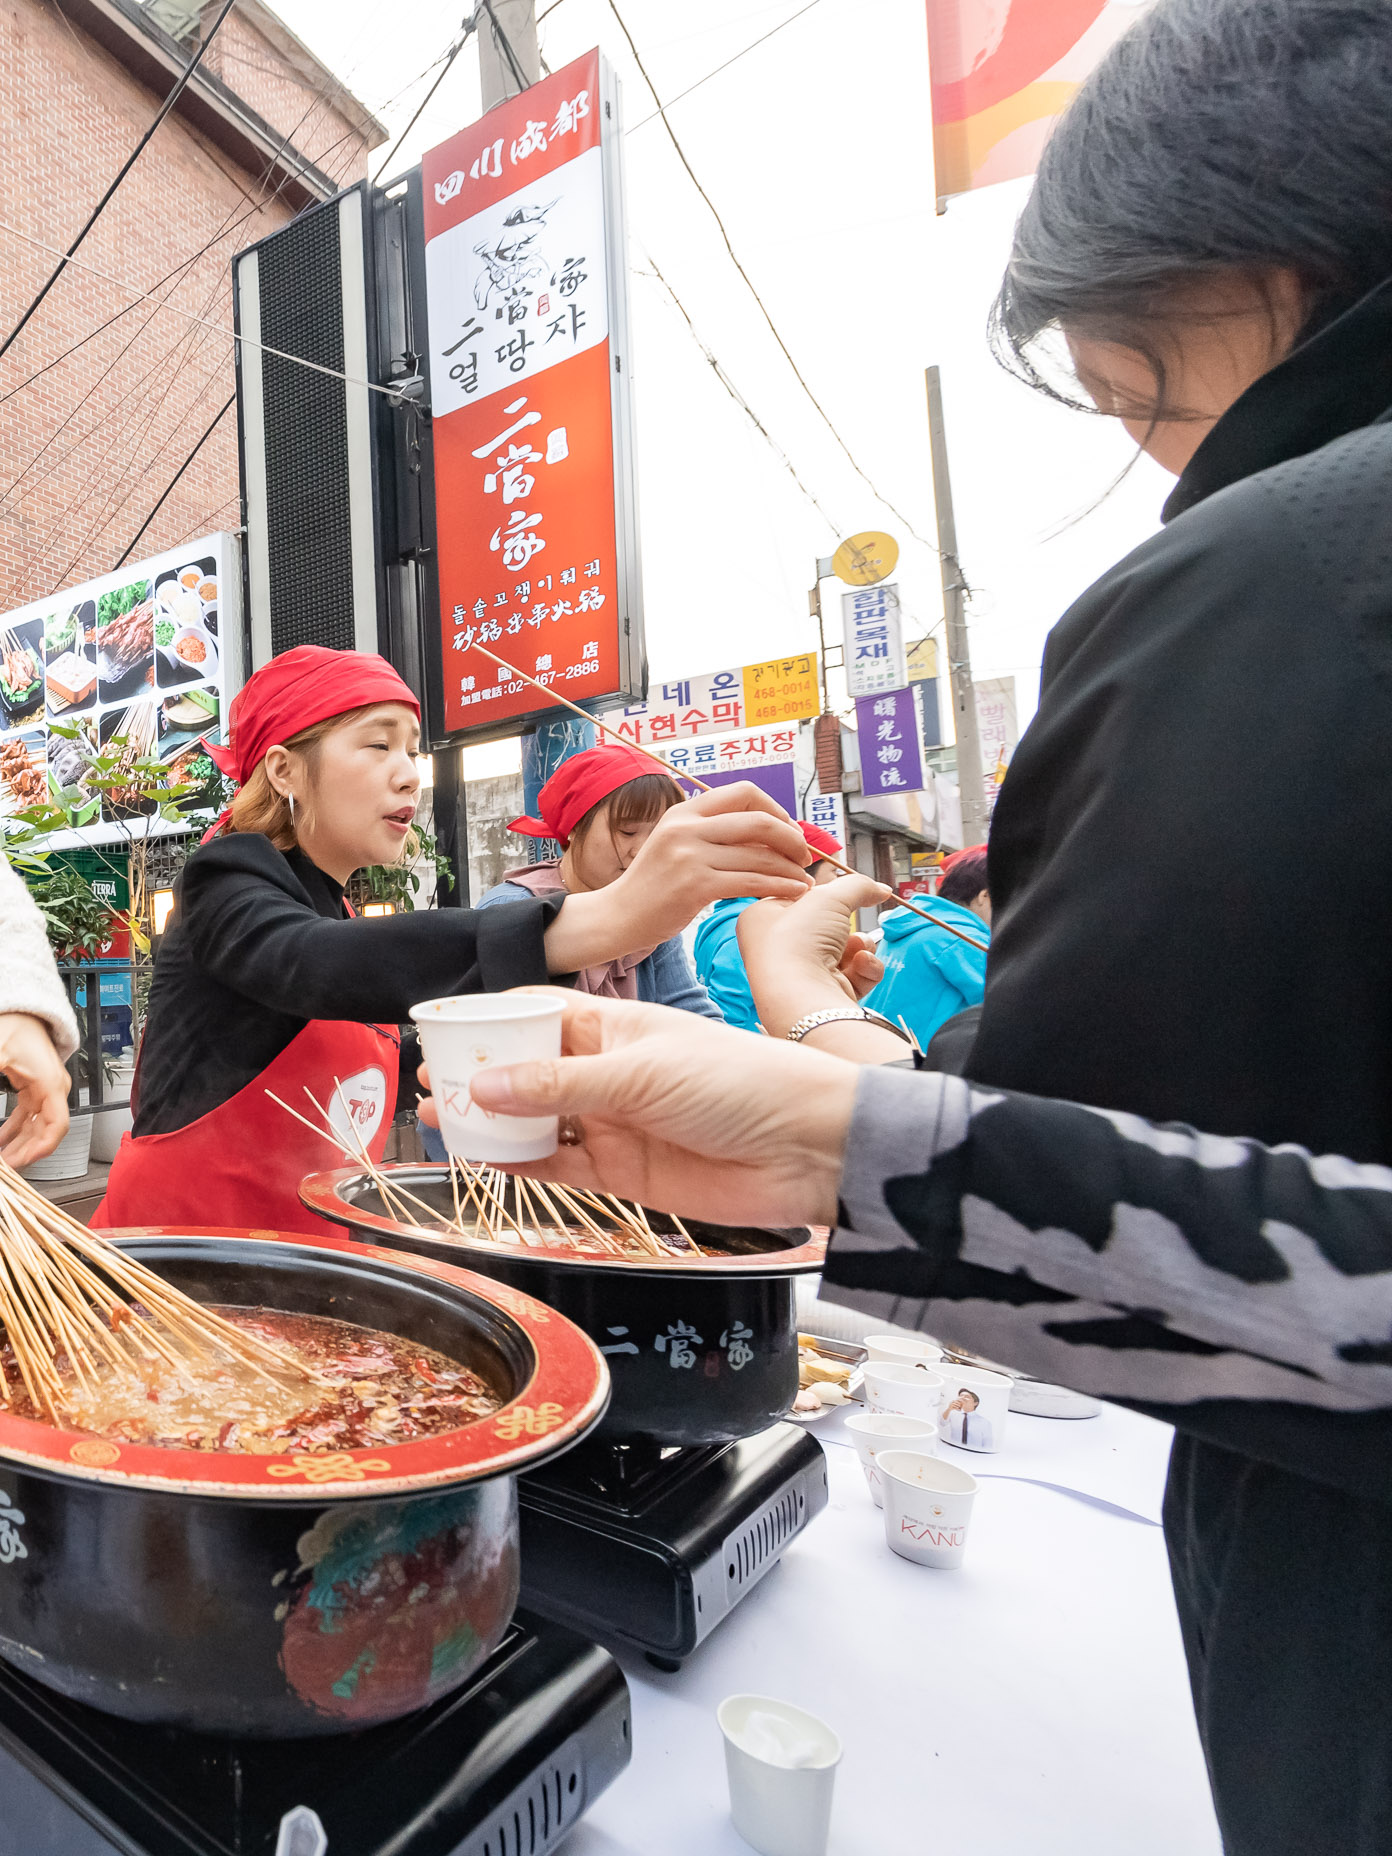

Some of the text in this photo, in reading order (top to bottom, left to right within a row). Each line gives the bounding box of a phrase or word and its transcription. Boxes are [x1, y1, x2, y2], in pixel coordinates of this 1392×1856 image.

[853, 588, 889, 660] 합판목재
[754, 680, 811, 699] 468-0014
[873, 696, 907, 787] 曙光物流
[349, 1098, 376, 1125] TOP
[901, 1519, 965, 1547] KANU
